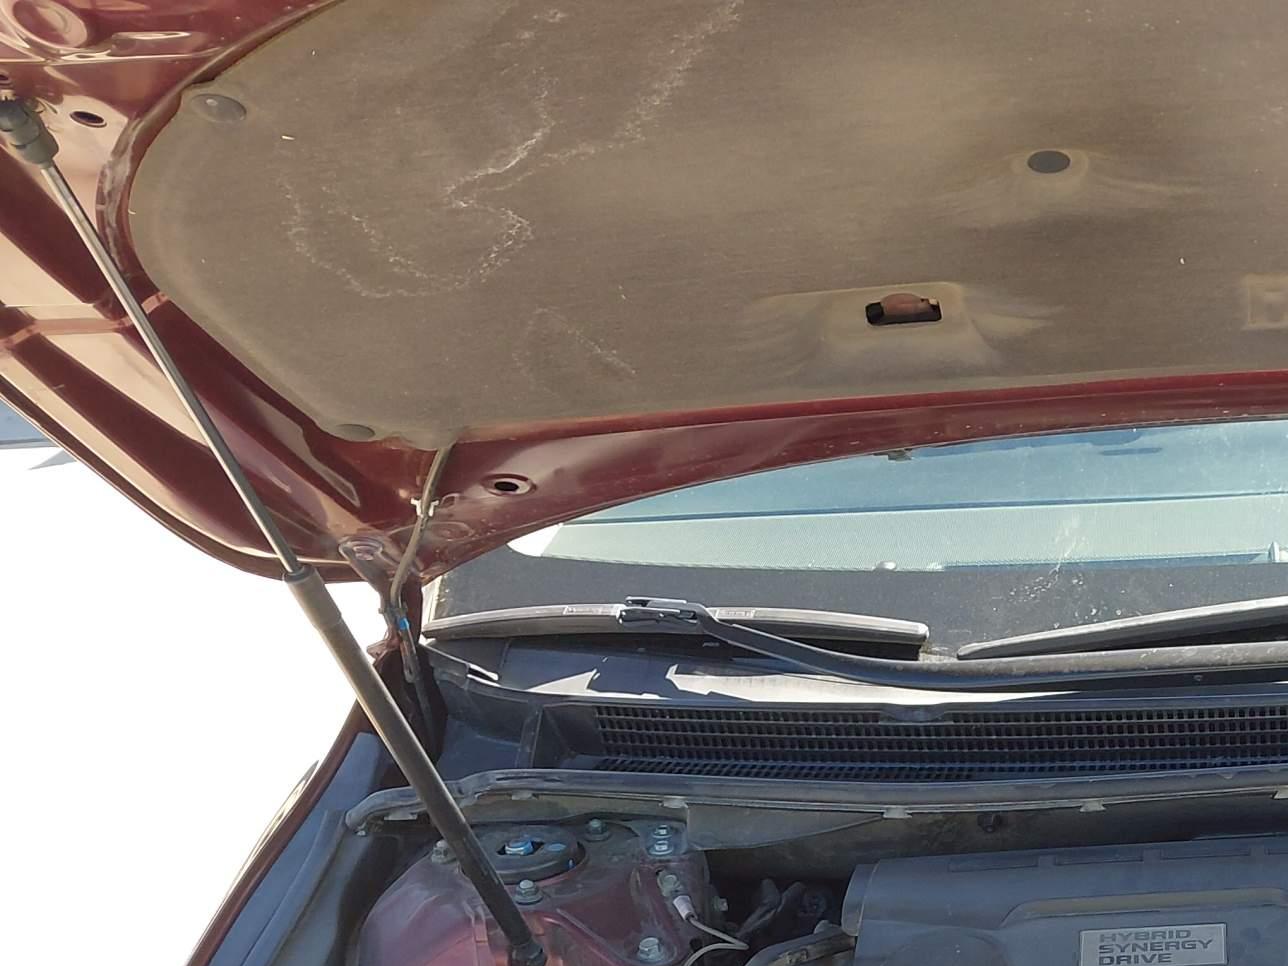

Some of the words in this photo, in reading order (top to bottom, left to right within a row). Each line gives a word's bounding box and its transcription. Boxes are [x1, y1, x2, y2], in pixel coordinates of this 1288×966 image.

[1099, 929, 1192, 943] HYBRID
[1098, 939, 1213, 954] SYNERGY
[1098, 953, 1172, 966] DRIVE
